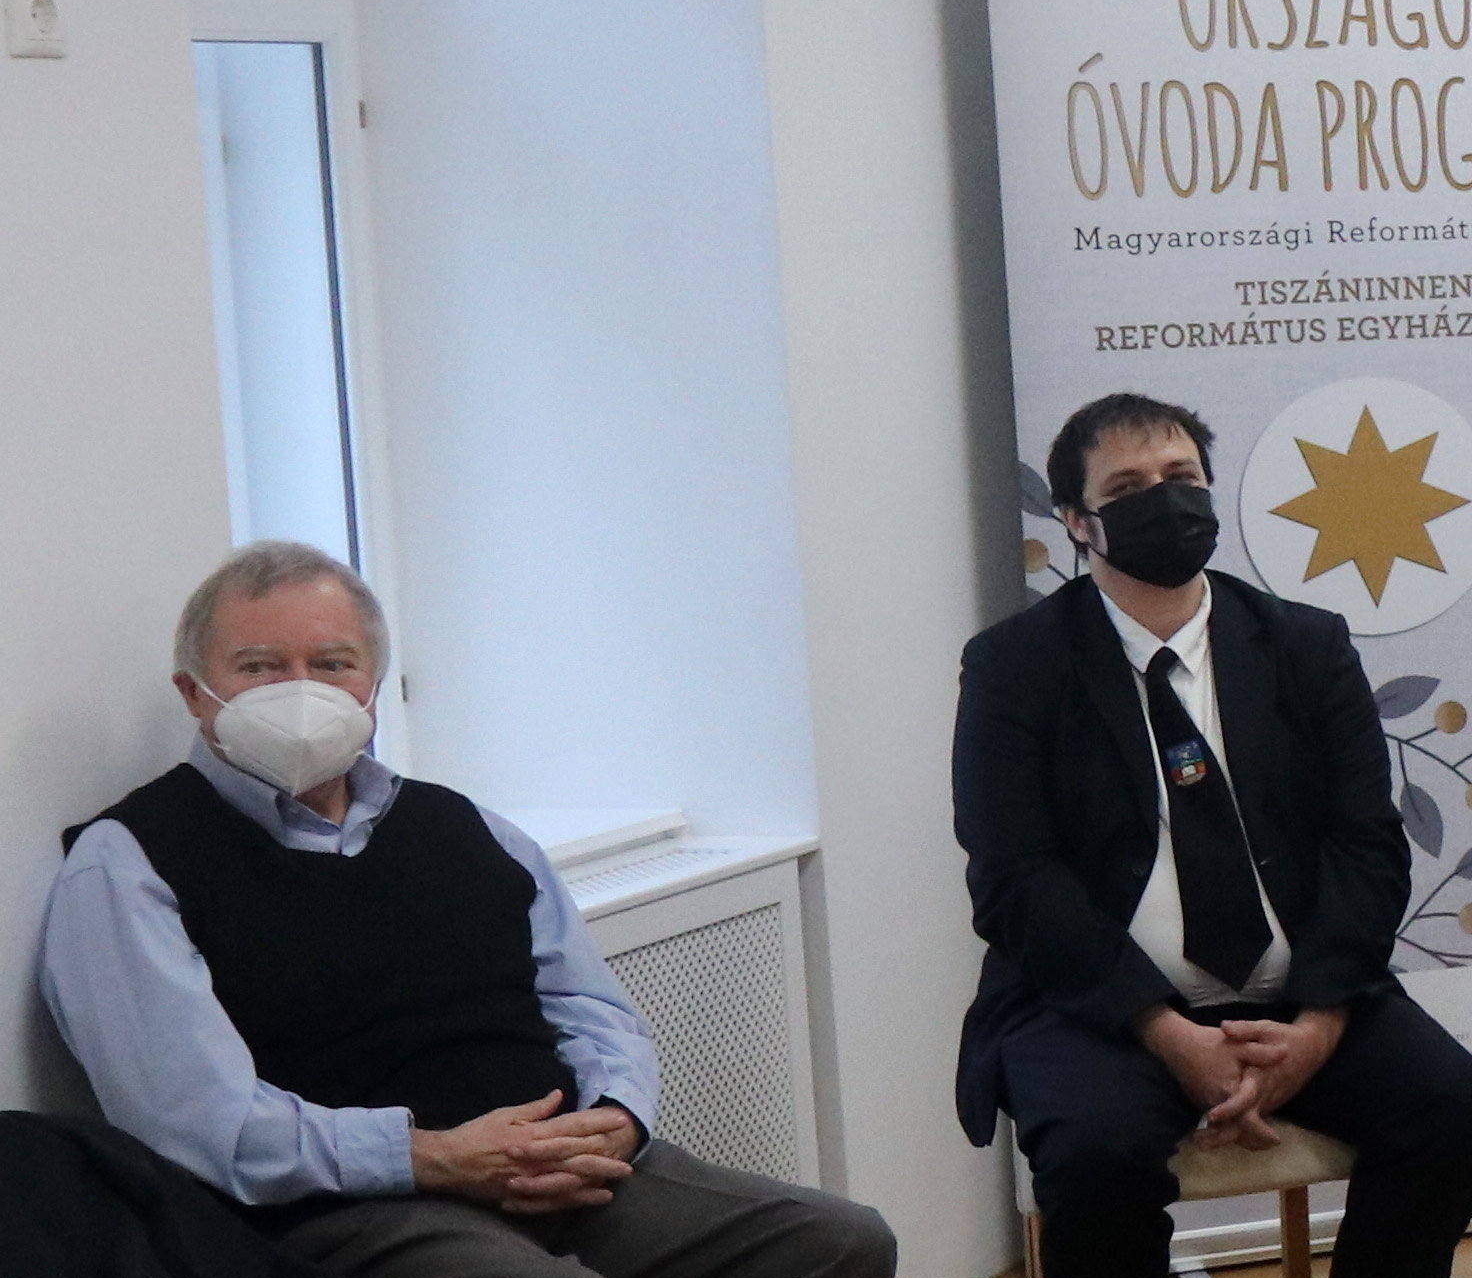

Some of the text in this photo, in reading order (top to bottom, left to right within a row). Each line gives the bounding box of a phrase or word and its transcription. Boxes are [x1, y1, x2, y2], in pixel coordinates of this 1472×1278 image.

[1066, 53, 1288, 201] ÓVODA
[1074, 222, 1313, 255] Magyarországi
[1096, 315, 1326, 351] REFORMÁTUS
